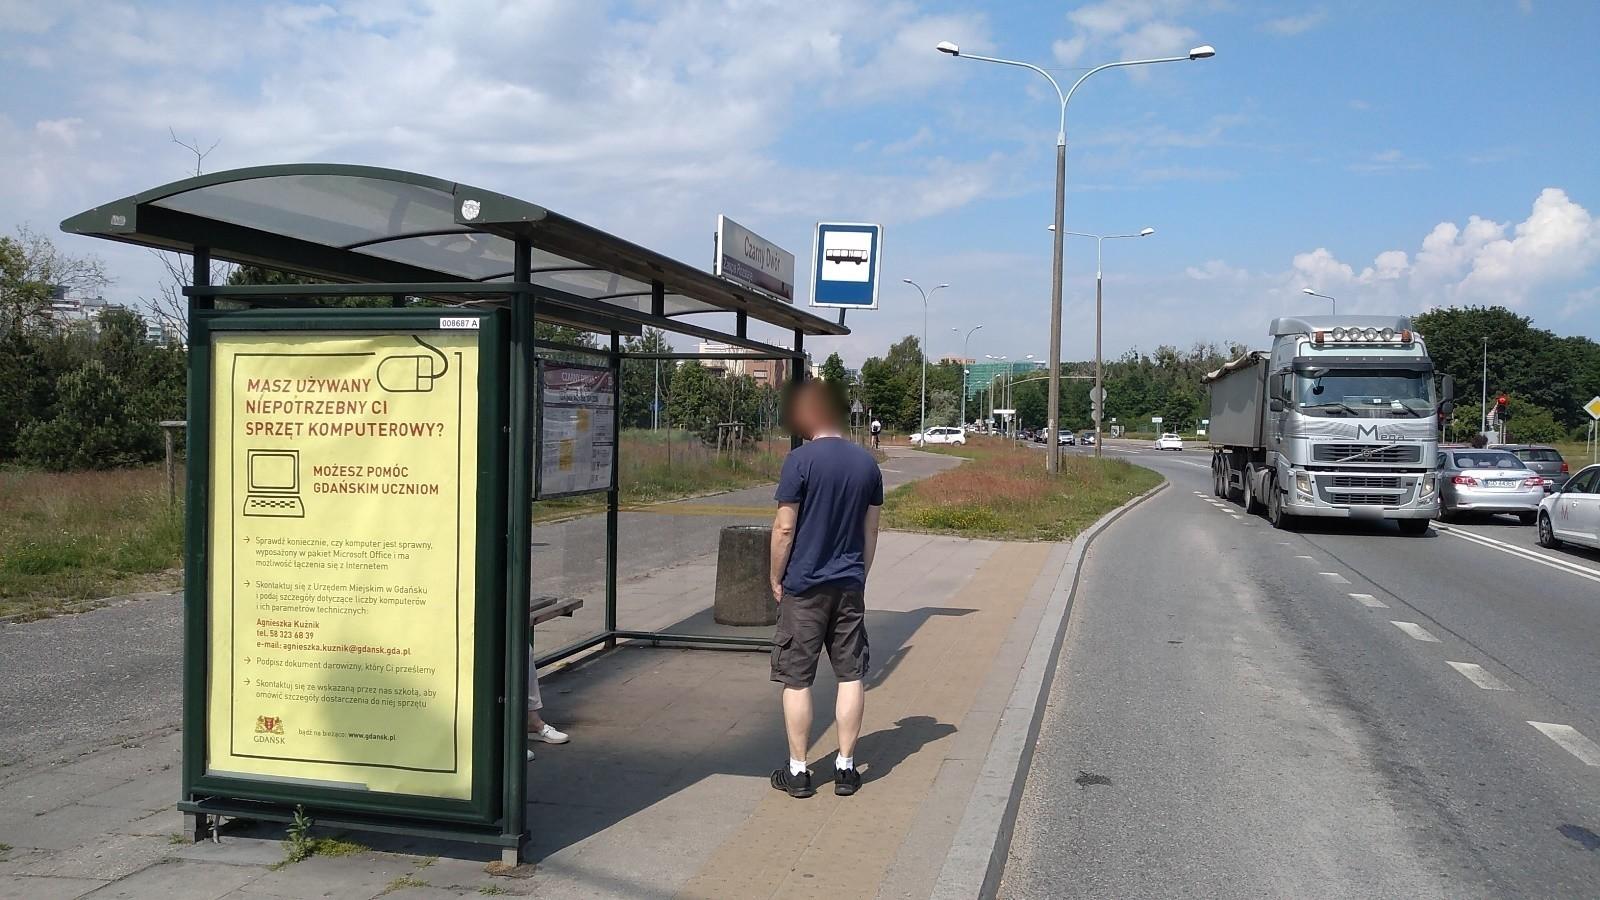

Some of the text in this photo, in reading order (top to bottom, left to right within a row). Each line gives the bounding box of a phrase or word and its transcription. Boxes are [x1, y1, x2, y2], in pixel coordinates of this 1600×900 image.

[744, 235, 765, 270] Czarny
[766, 247, 781, 273] Dwór
[442, 319, 469, 327] 008687
[247, 376, 371, 393] MASZ UŻYWANY
[246, 400, 387, 415] NIEPOTRZEBNY CI
[246, 422, 444, 440] SPRZĘT KOMPUTEROWY?
[313, 463, 409, 478] MOŻESZ POMÓC
[313, 480, 439, 495] GDAŃSKIM UCZNIOM
[330, 540, 343, 548] czy
[345, 540, 382, 549] komputer
[383, 541, 397, 549] jest
[398, 542, 433, 550] sprawny,
[307, 550, 331, 558] pakiet
[333, 550, 367, 558] Microsoft
[369, 551, 392, 559] Office
[327, 561, 338, 570] się
[345, 561, 389, 570] Internetem
[255, 580, 293, 591] Skontaktuj
[294, 583, 306, 591] się
[313, 583, 347, 592] Urzędem
[349, 584, 384, 593] Miejskim
[394, 585, 428, 594] Gdańsku
[259, 593, 279, 601] podaj
[279, 593, 315, 603] szczegóły
[316, 594, 353, 604] dotyczące
[355, 595, 377, 605] liczby
[379, 596, 426, 606] komputerów
[259, 603, 270, 611] ich
[317, 606, 369, 616] technicznych:
[256, 618, 292, 628] Agnieszka
[269, 630, 278, 638] 58
[279, 631, 292, 639] 323
[294, 632, 304, 640] 68
[305, 632, 314, 640] 39
[256, 641, 412, 656] e-mail: agnieszka.kuznik@gdansk.gda.pl
[256, 657, 436, 676] Podpisz dokument darowizny, który Ci prześlemy
[255, 679, 293, 691] Skontaktuj
[294, 682, 306, 692] się
[317, 684, 355, 693] wskazaną
[356, 687, 377, 695] przez
[423, 689, 437, 698] aby
[320, 694, 368, 705] dostarczenia
[370, 697, 380, 705] do
[381, 698, 396, 707] niej
[397, 700, 427, 708] sprzętu
[348, 732, 396, 742] www.gdansk.pl
